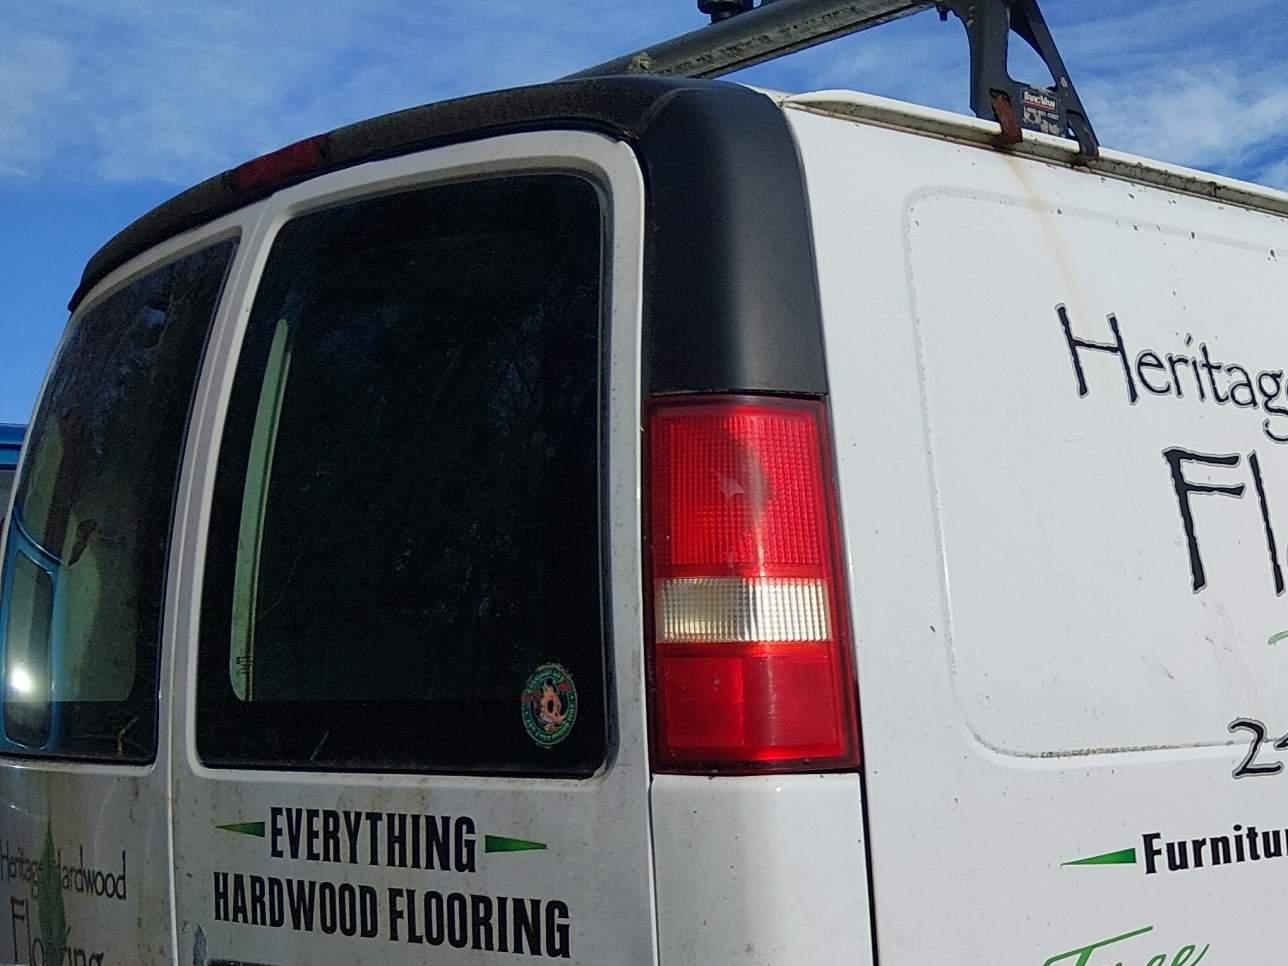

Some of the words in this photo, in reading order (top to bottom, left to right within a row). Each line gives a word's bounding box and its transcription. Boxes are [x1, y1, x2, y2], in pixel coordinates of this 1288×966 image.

[270, 806, 478, 873] EVERYTHING
[212, 872, 379, 939] HARDWOOD
[387, 888, 571, 959] FLOORING
